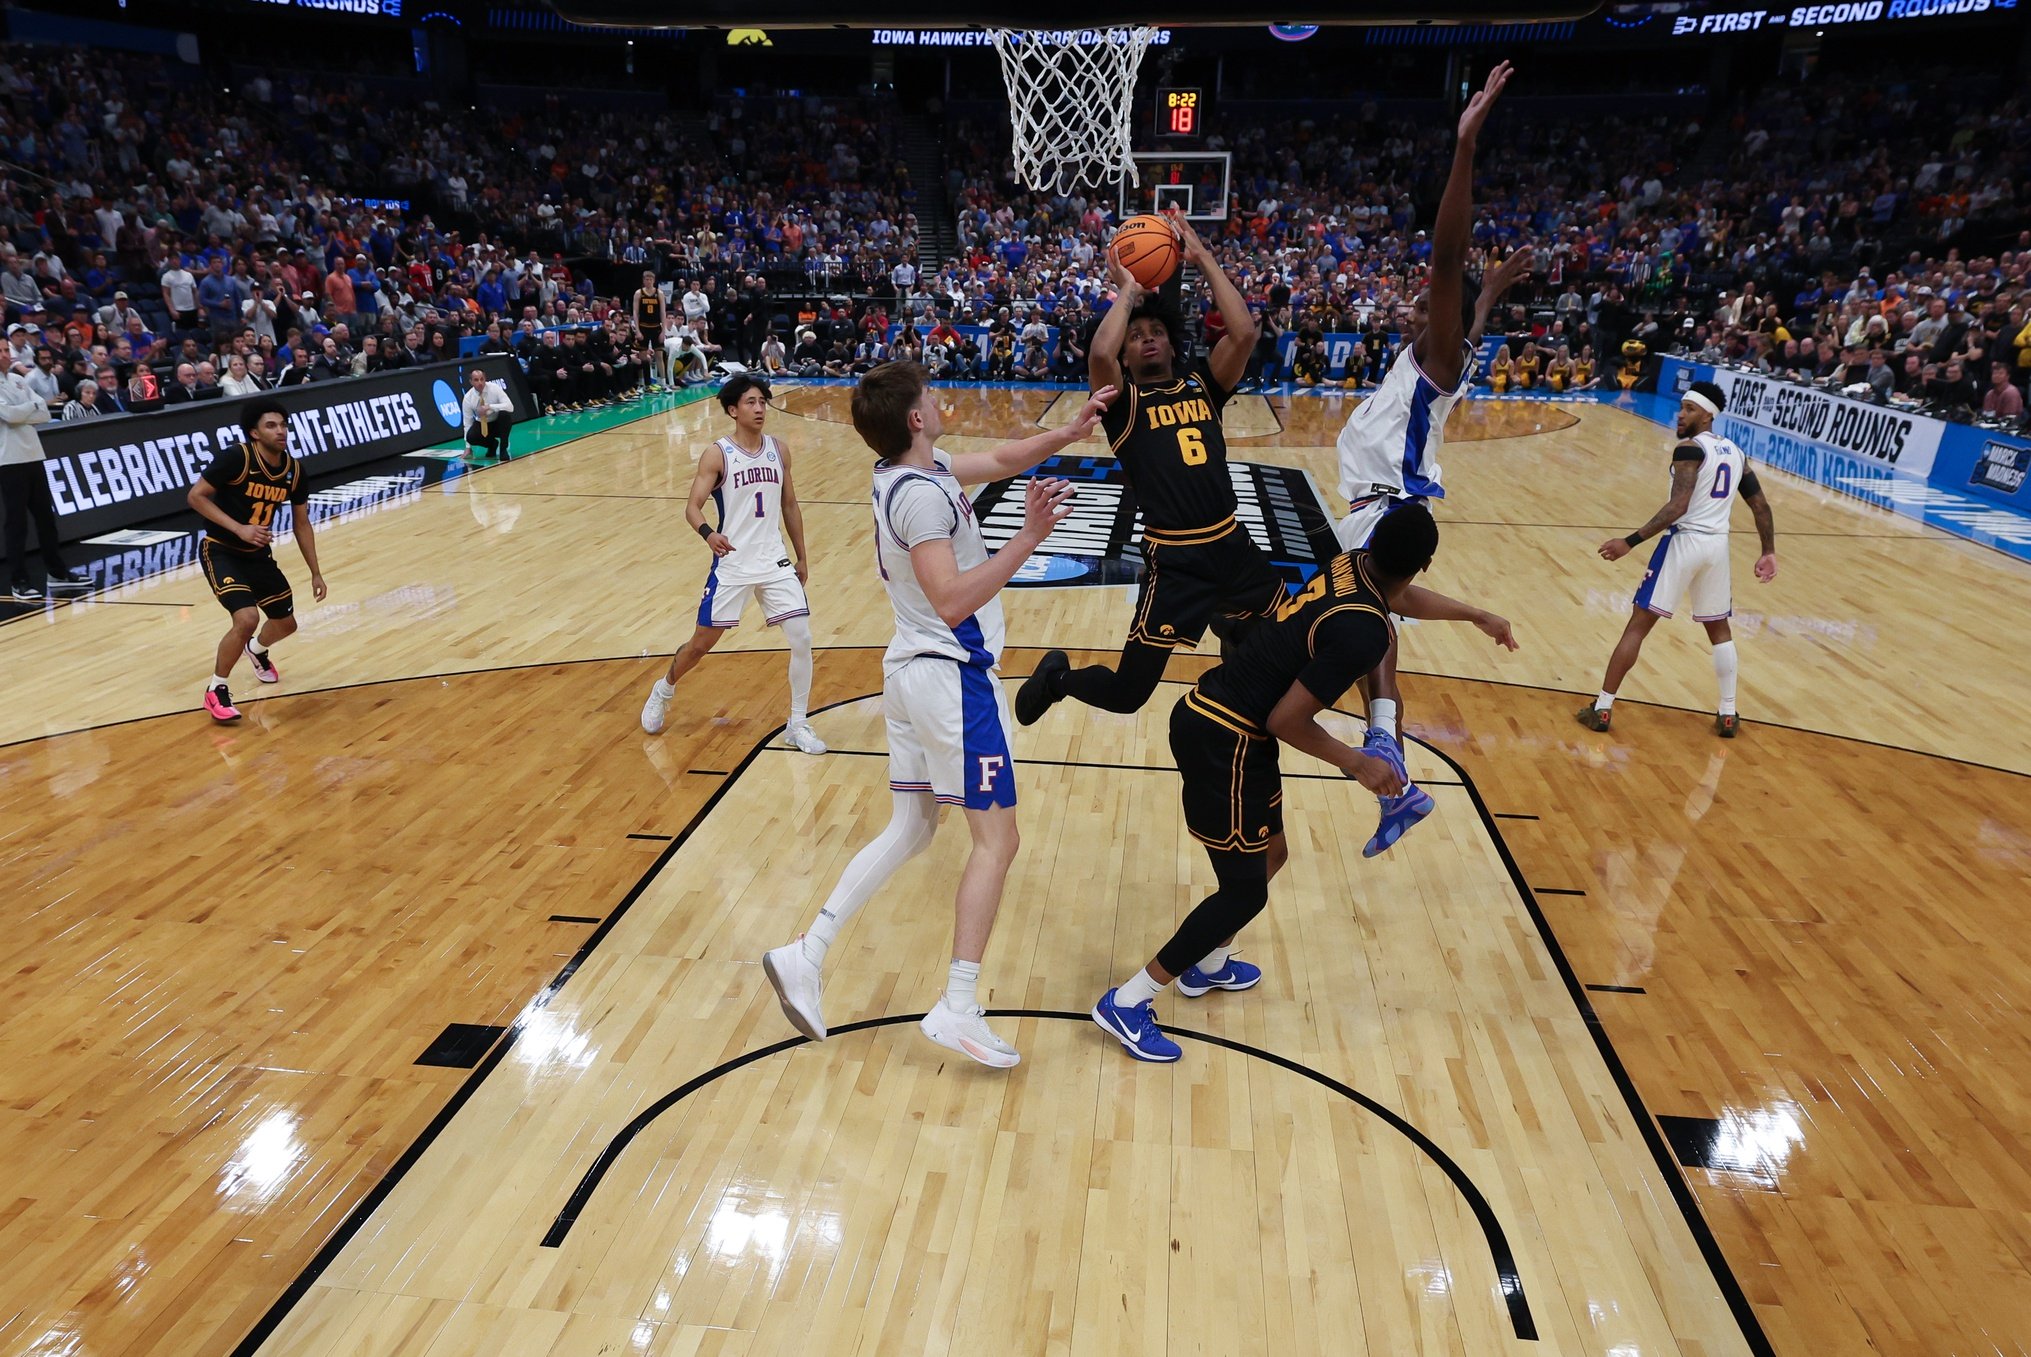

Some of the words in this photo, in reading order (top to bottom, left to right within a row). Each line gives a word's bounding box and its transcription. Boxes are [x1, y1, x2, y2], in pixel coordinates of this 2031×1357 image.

[1700, 11, 1766, 33] FIRST
[1768, 15, 1785, 24] AND
[1789, 1, 1883, 26] SECOND
[872, 30, 915, 45] IOWA
[1168, 93, 1197, 107] 8:22
[1172, 107, 1192, 132] 18
[440, 401, 461, 416] NCAA
[1146, 399, 1212, 430] IOWA
[1728, 378, 1767, 420] FIRST
[1773, 387, 1833, 440] SECOND
[1826, 403, 1912, 464] ROUNDS
[42, 431, 214, 516] ELEBRATES
[216, 391, 422, 459] ENT-ATHLETES
[1176, 427, 1207, 467] 6
[734, 467, 780, 489] FLORIDA
[1710, 462, 1731, 498] 0
[245, 481, 287, 502] IOWA
[249, 501, 274, 526] 11
[755, 492, 765, 518] 1
[977, 755, 1004, 792] F
